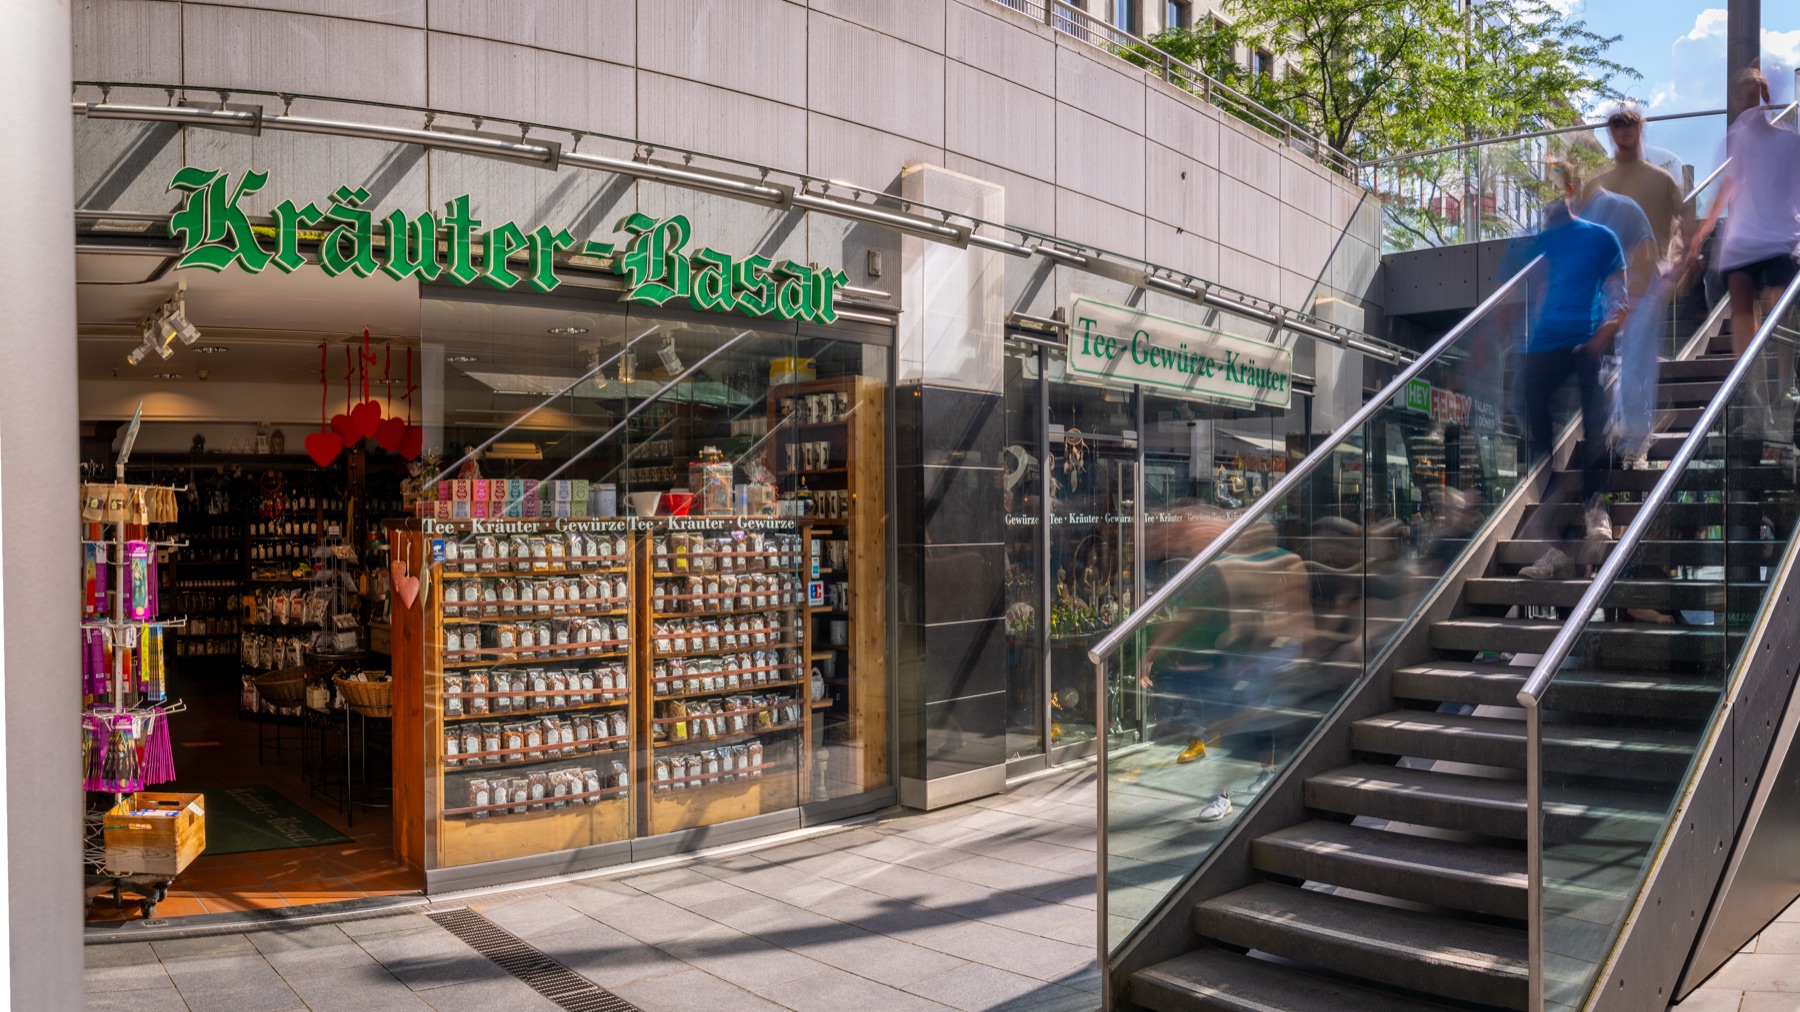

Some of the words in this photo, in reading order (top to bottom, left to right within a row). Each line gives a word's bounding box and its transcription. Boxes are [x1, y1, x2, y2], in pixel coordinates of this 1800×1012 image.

[167, 166, 851, 325] Kräuter-Basar
[1409, 383, 1429, 406] HEY
[1431, 388, 1472, 427] FERRY
[423, 518, 455, 534] Tee
[472, 517, 540, 533] Kräuter
[555, 517, 626, 532] Gewürze
[627, 516, 654, 531] Tee
[668, 516, 724, 530] Kräuter
[737, 515, 795, 529] Gewürze
[1005, 513, 1039, 525] Gewürze
[1049, 513, 1063, 524] Tee
[1069, 513, 1099, 524] Kräuter
[1144, 512, 1155, 523] Tee
[1160, 512, 1182, 523] Kräuter
